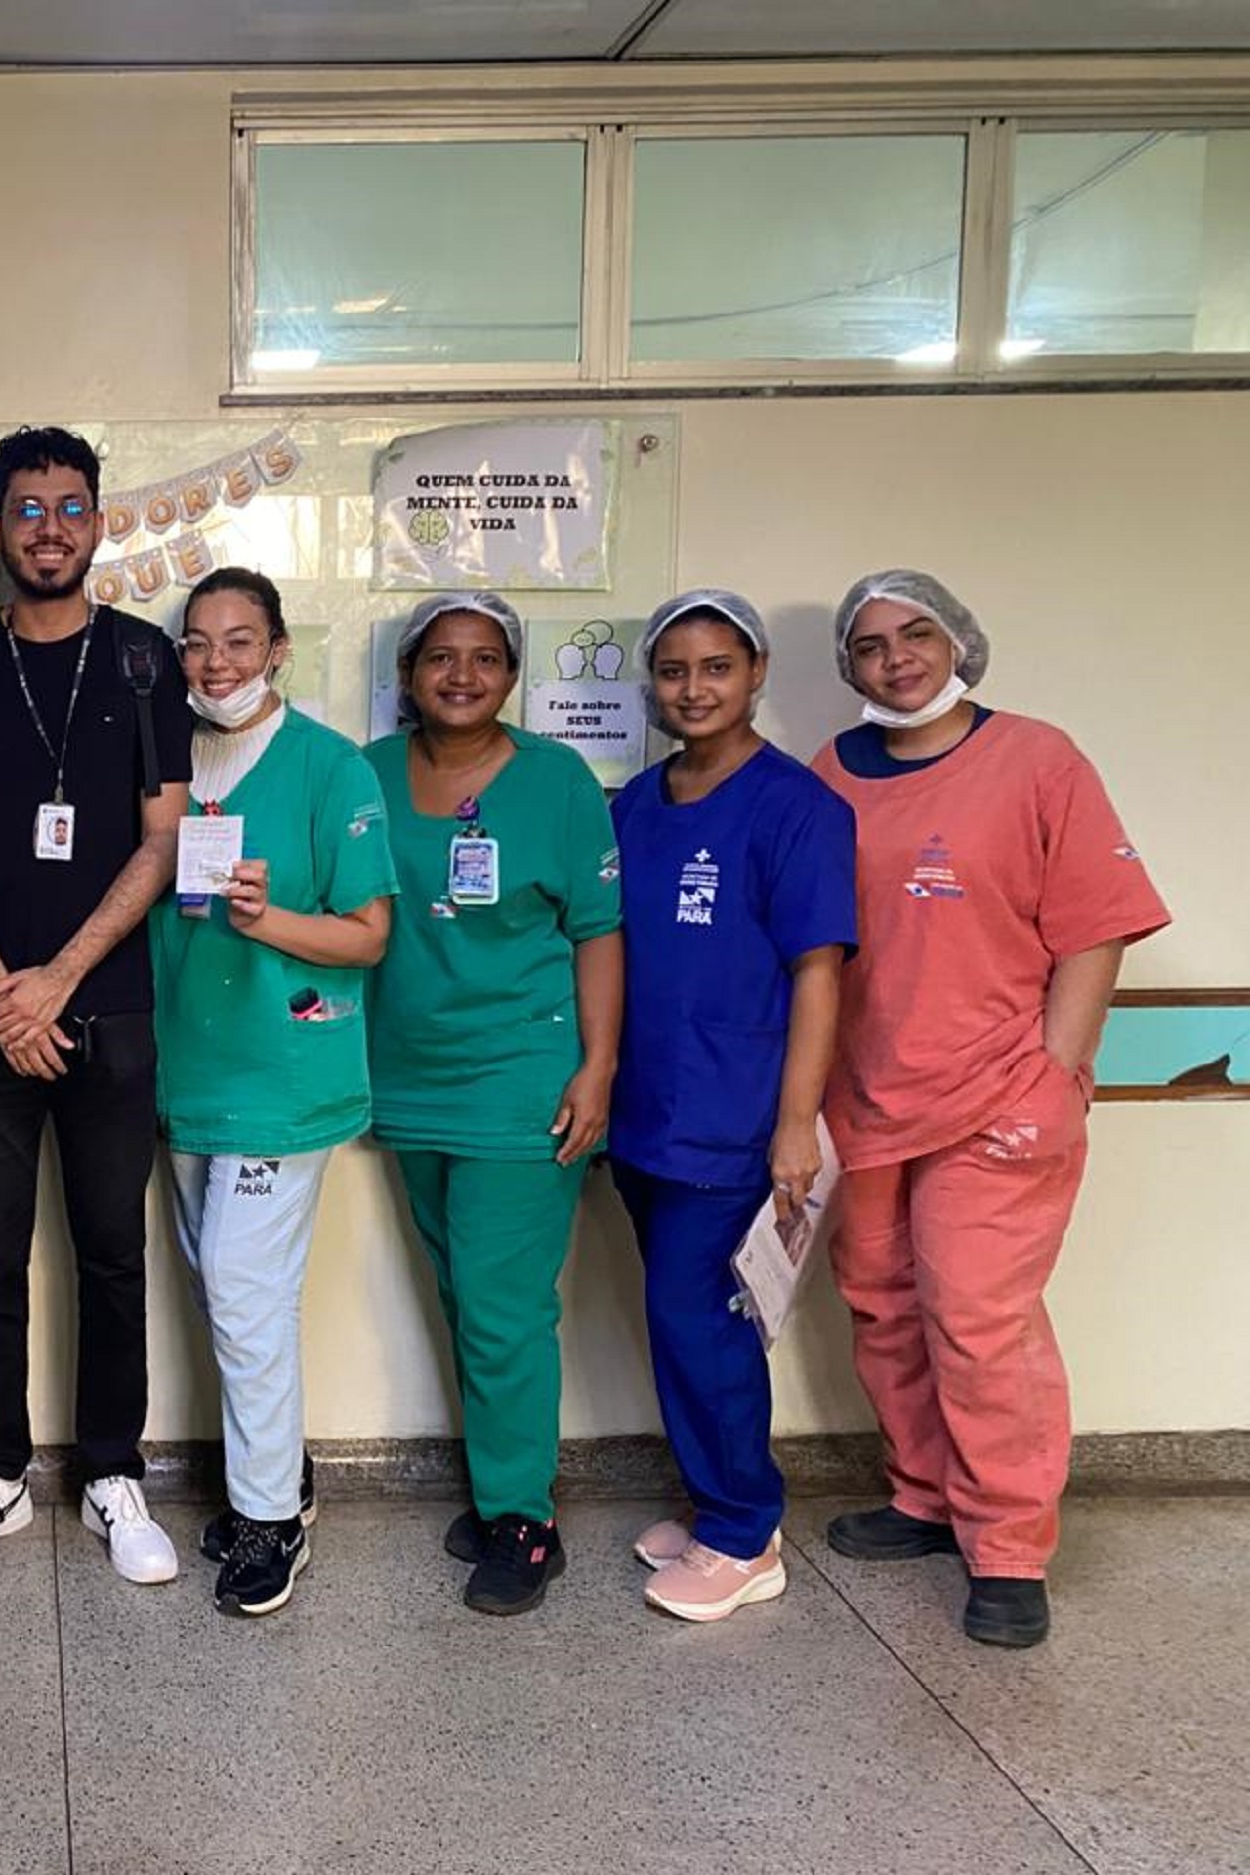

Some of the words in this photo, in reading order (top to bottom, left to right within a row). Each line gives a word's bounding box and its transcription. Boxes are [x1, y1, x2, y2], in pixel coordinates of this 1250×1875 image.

[416, 474, 474, 488] QUEM
[479, 474, 539, 487] CUIDA
[544, 474, 571, 487] DA
[406, 496, 481, 510] MENTE,
[486, 496, 546, 509] CUIDA
[552, 497, 578, 509] DA
[470, 518, 516, 530] VIDA
[548, 700, 578, 710] Fale
[582, 700, 622, 710] sobre
[566, 716, 602, 725] SEUS
